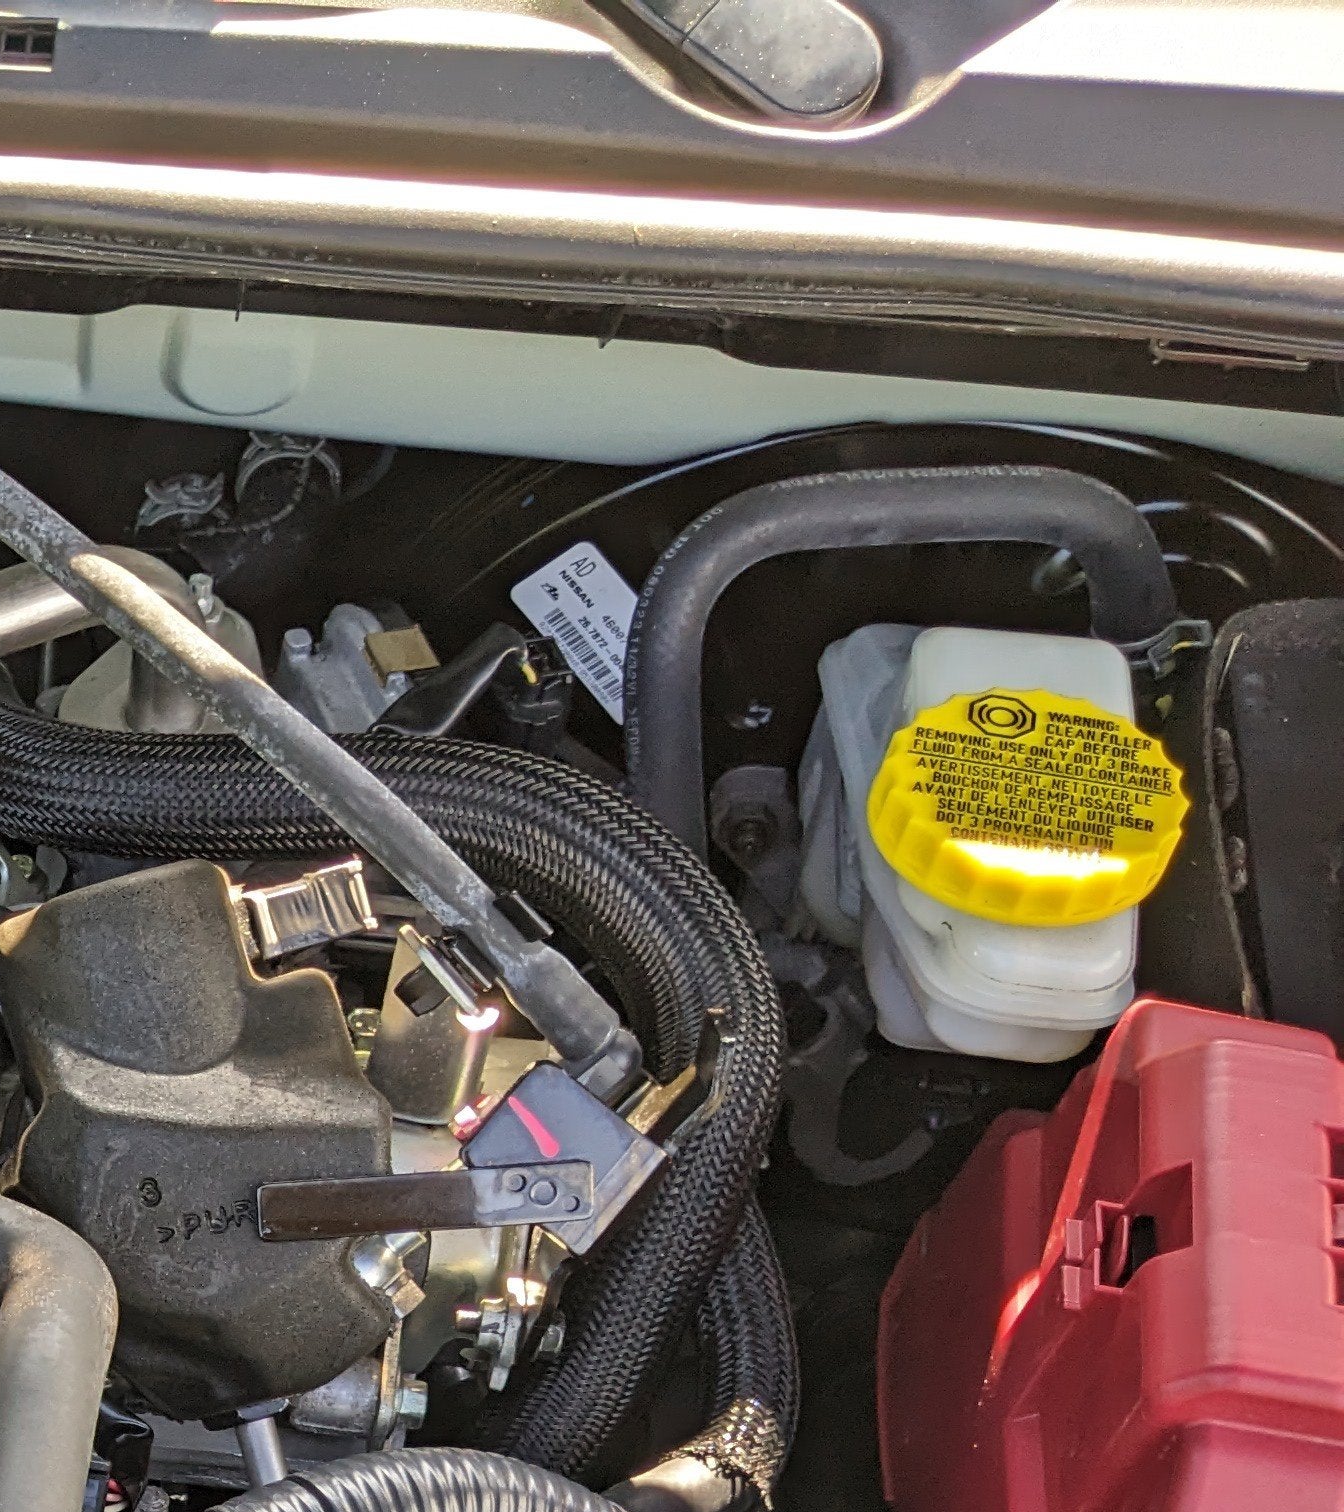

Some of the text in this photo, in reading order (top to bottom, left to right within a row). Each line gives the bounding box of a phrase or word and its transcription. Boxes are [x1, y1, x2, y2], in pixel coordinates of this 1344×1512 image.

[559, 570, 594, 609] NISSAN
[1045, 710, 1120, 733] WARNING:
[1045, 723, 1151, 751] CLEAN FILLER
[912, 737, 1177, 794] FLUID FROM A SEALED CONTAINER.
[998, 740, 1025, 754] USE
[1029, 746, 1067, 761] ONLY
[1073, 752, 1100, 767] DOT
[1105, 758, 1116, 770] 3
[1119, 761, 1171, 779] BRAKE
[1044, 735, 1139, 761] CAP BEFORE
[911, 780, 1154, 832] AVANT DE L'ENLEVER UTILISER
[931, 771, 1134, 816] BOUCHON DE REMPLISSAGE
[1050, 778, 1130, 803] NETTOYER
[1133, 793, 1153, 806] LE
[935, 810, 963, 825] DOT
[969, 815, 978, 827] 3
[982, 817, 1072, 843] PROVENANT
[937, 797, 1114, 838] SEULEMENT DU LIQUIDE
